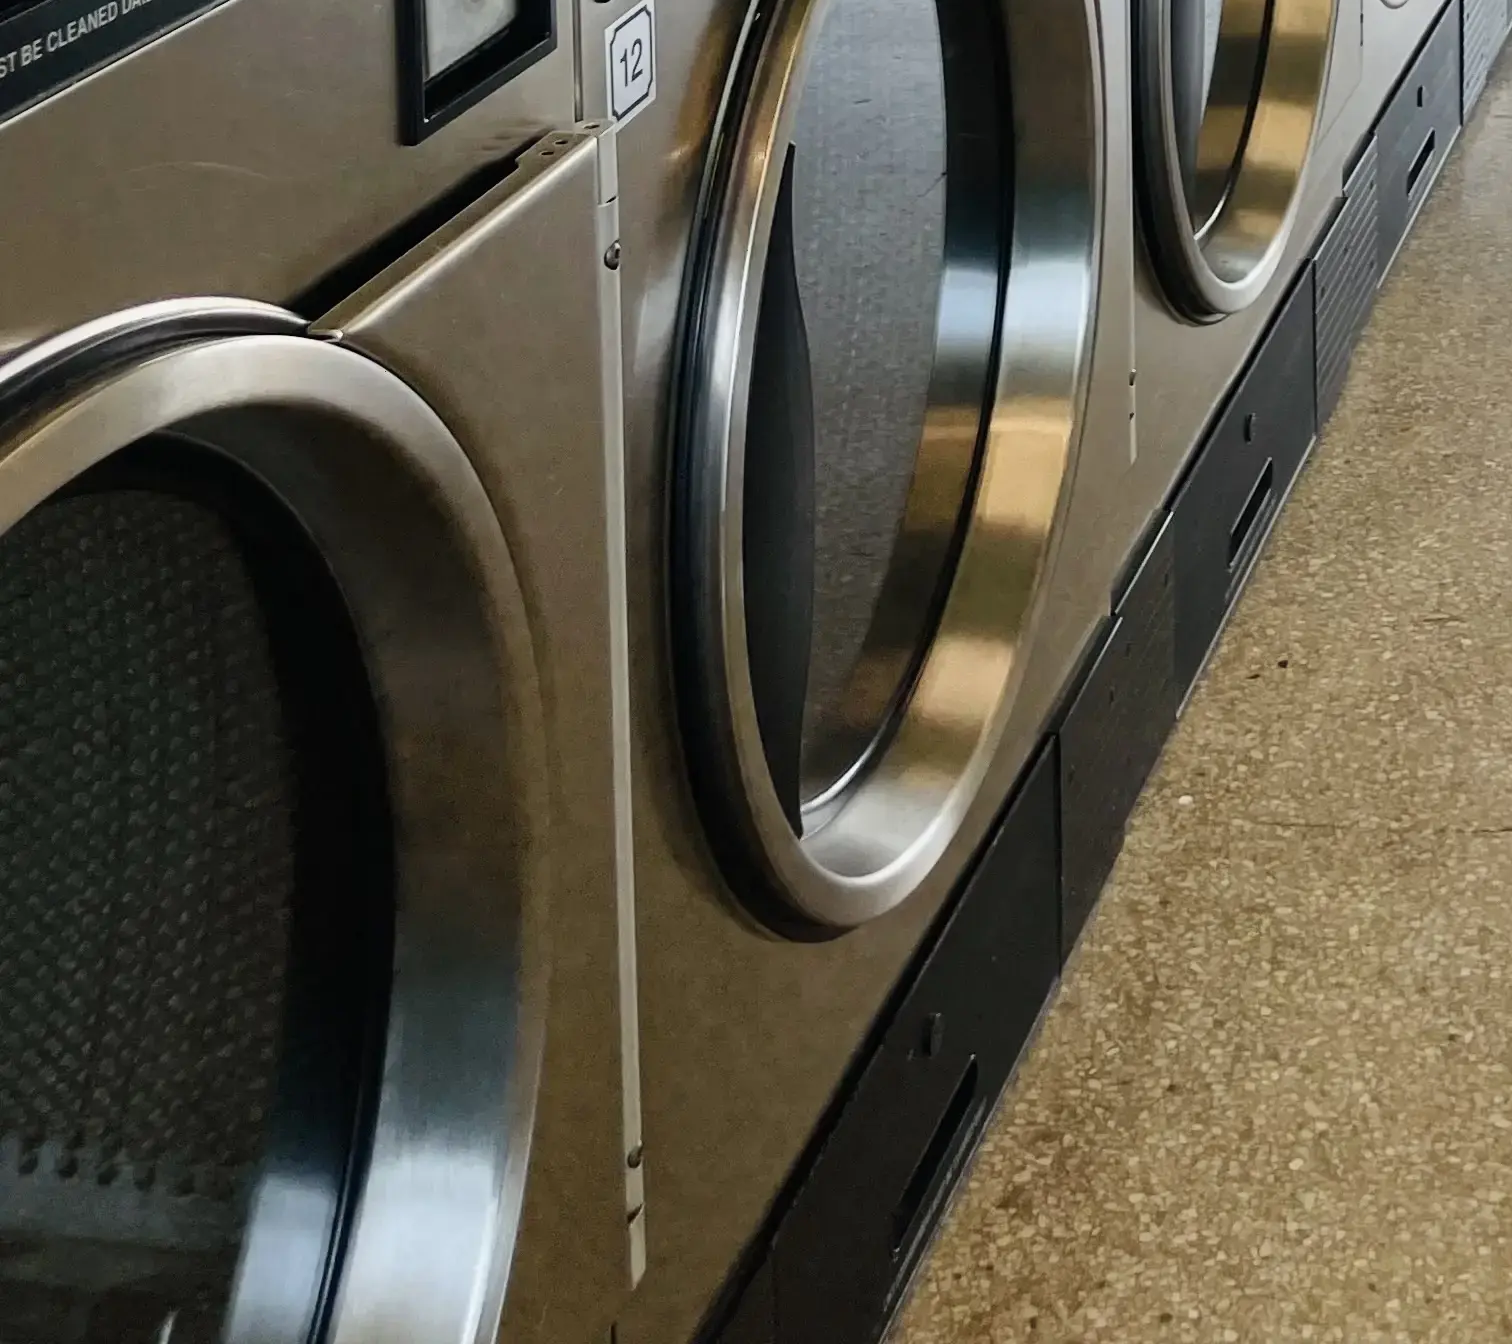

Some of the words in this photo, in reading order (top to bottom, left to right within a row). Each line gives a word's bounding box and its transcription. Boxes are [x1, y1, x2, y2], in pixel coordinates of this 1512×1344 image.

[21, 39, 43, 67] BE
[46, 0, 118, 53] CLEANED
[619, 37, 644, 88] 12
